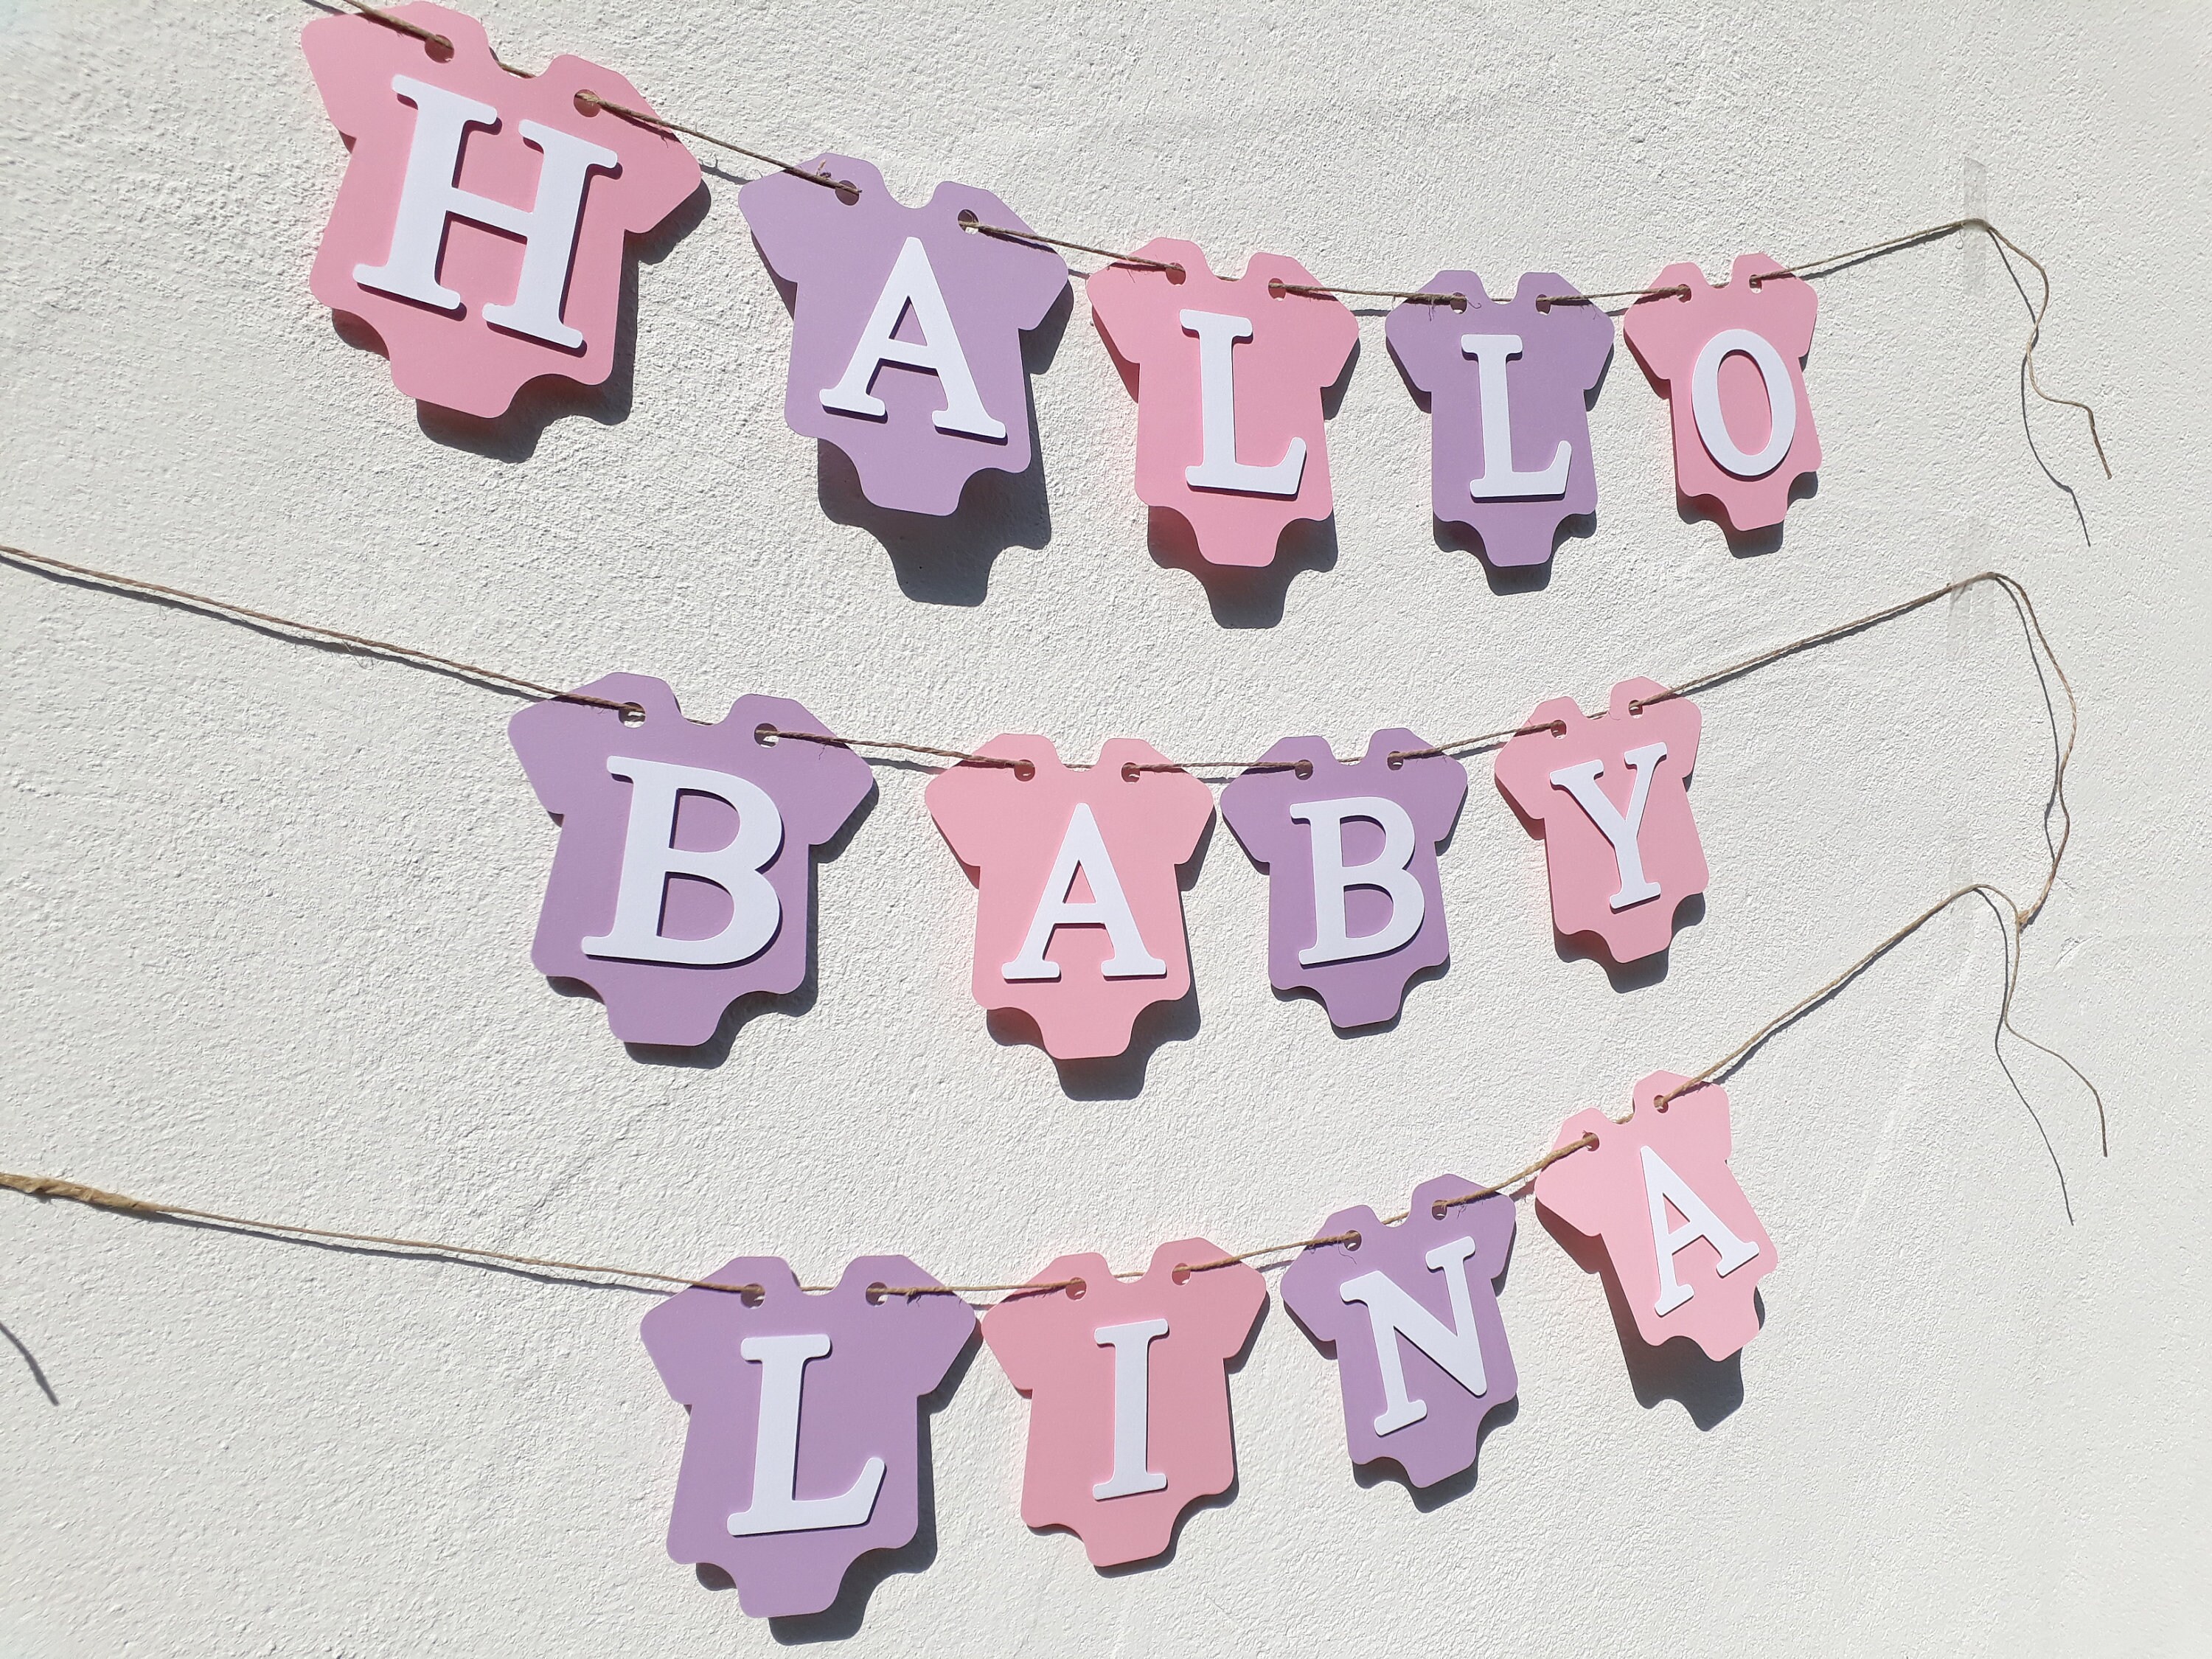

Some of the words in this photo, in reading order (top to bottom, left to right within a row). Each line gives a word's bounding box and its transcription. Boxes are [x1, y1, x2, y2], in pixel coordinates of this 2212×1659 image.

[352, 74, 1797, 498] HALLO
[581, 741, 1668, 979] BABY
[728, 1145, 1760, 1536] LINA
